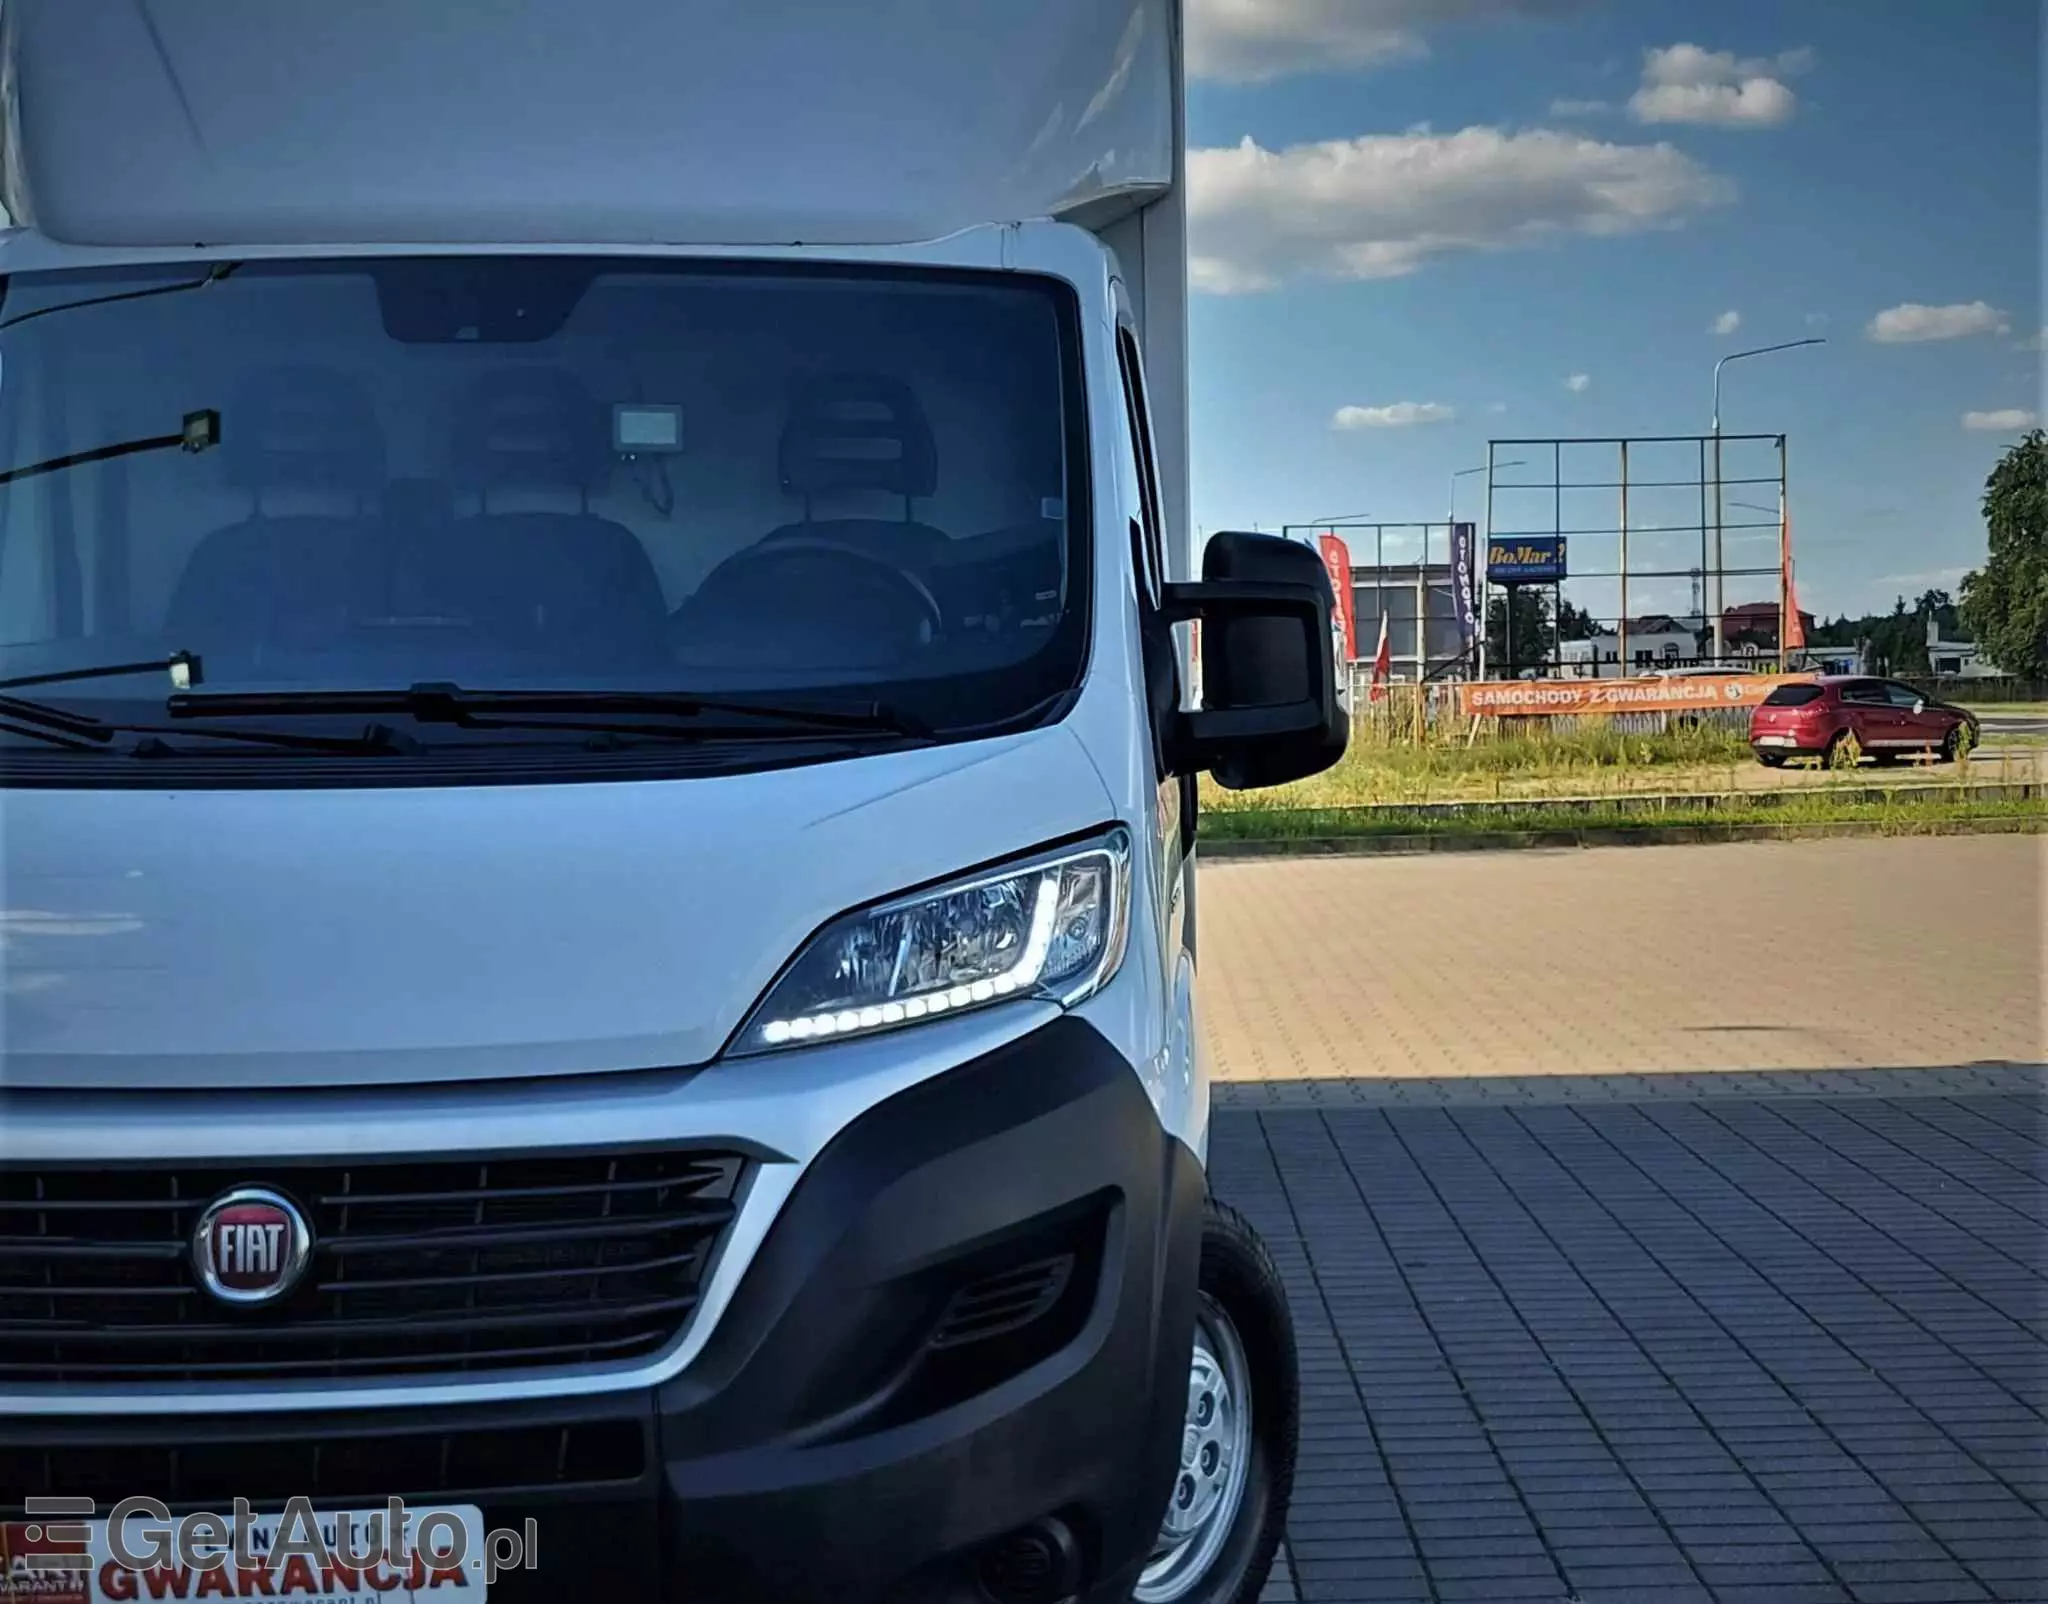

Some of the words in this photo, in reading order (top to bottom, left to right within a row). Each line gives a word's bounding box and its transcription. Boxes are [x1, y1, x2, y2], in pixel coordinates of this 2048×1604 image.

[1458, 536, 1474, 624] OTOMOTO
[1472, 688, 1582, 706] SAMOCHODY
[1590, 688, 1604, 703] Z
[220, 1223, 284, 1273] FIAT
[99, 1545, 470, 1601] GWARANCJA
